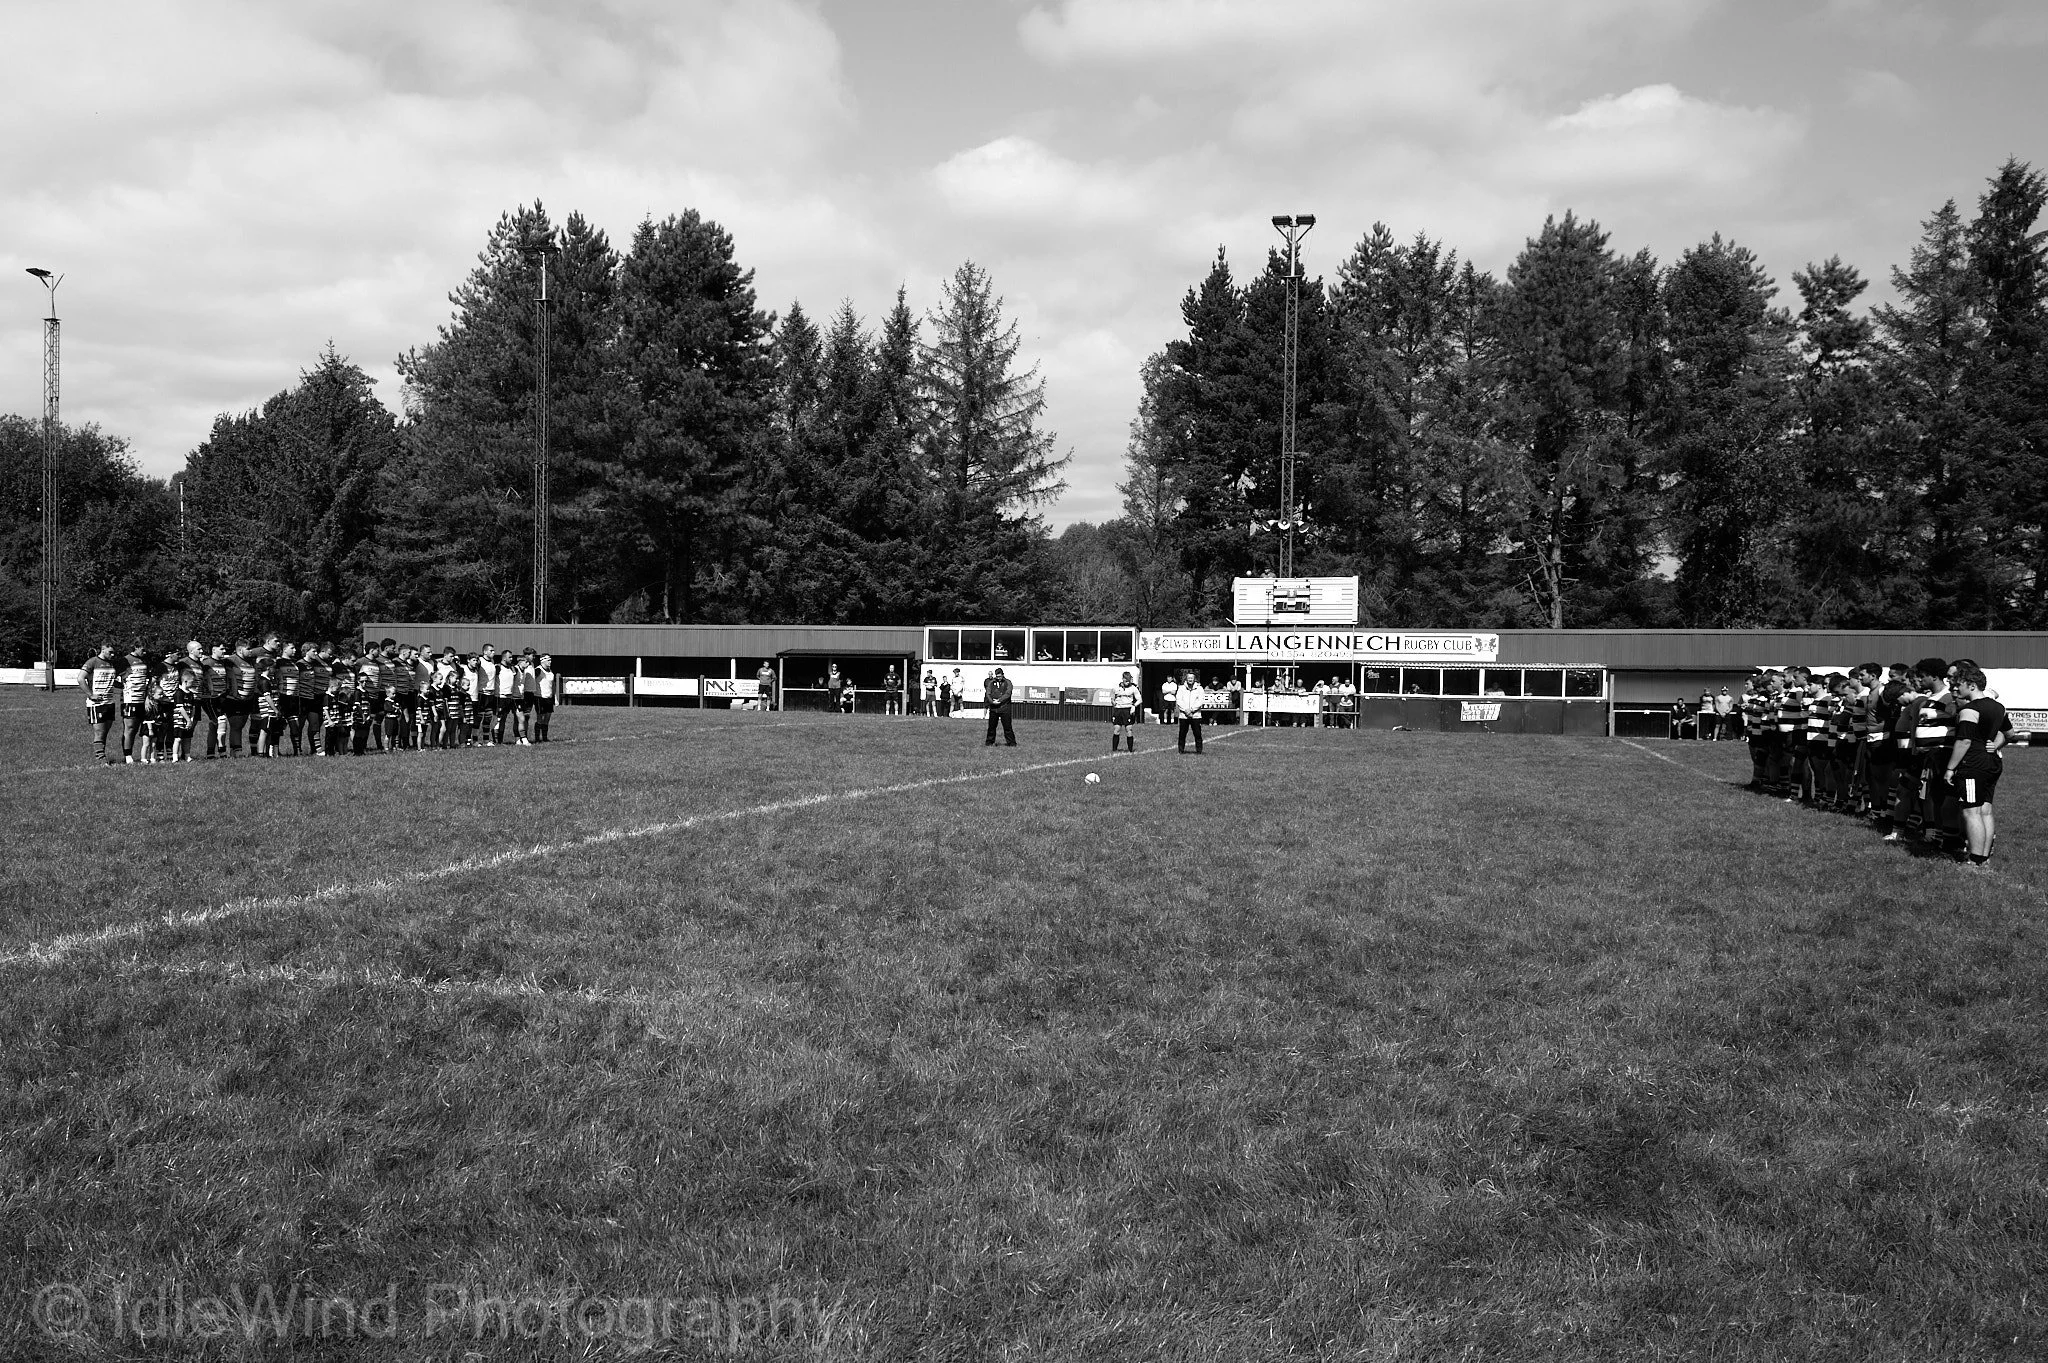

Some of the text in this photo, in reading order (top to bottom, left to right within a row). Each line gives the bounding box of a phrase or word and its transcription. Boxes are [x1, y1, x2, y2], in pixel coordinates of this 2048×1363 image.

[1192, 639, 1221, 649] RYGBI
[1226, 635, 1400, 650] LLANGENNECH
[1404, 640, 1440, 650] RUGBY
[1443, 640, 1472, 651] CLUB
